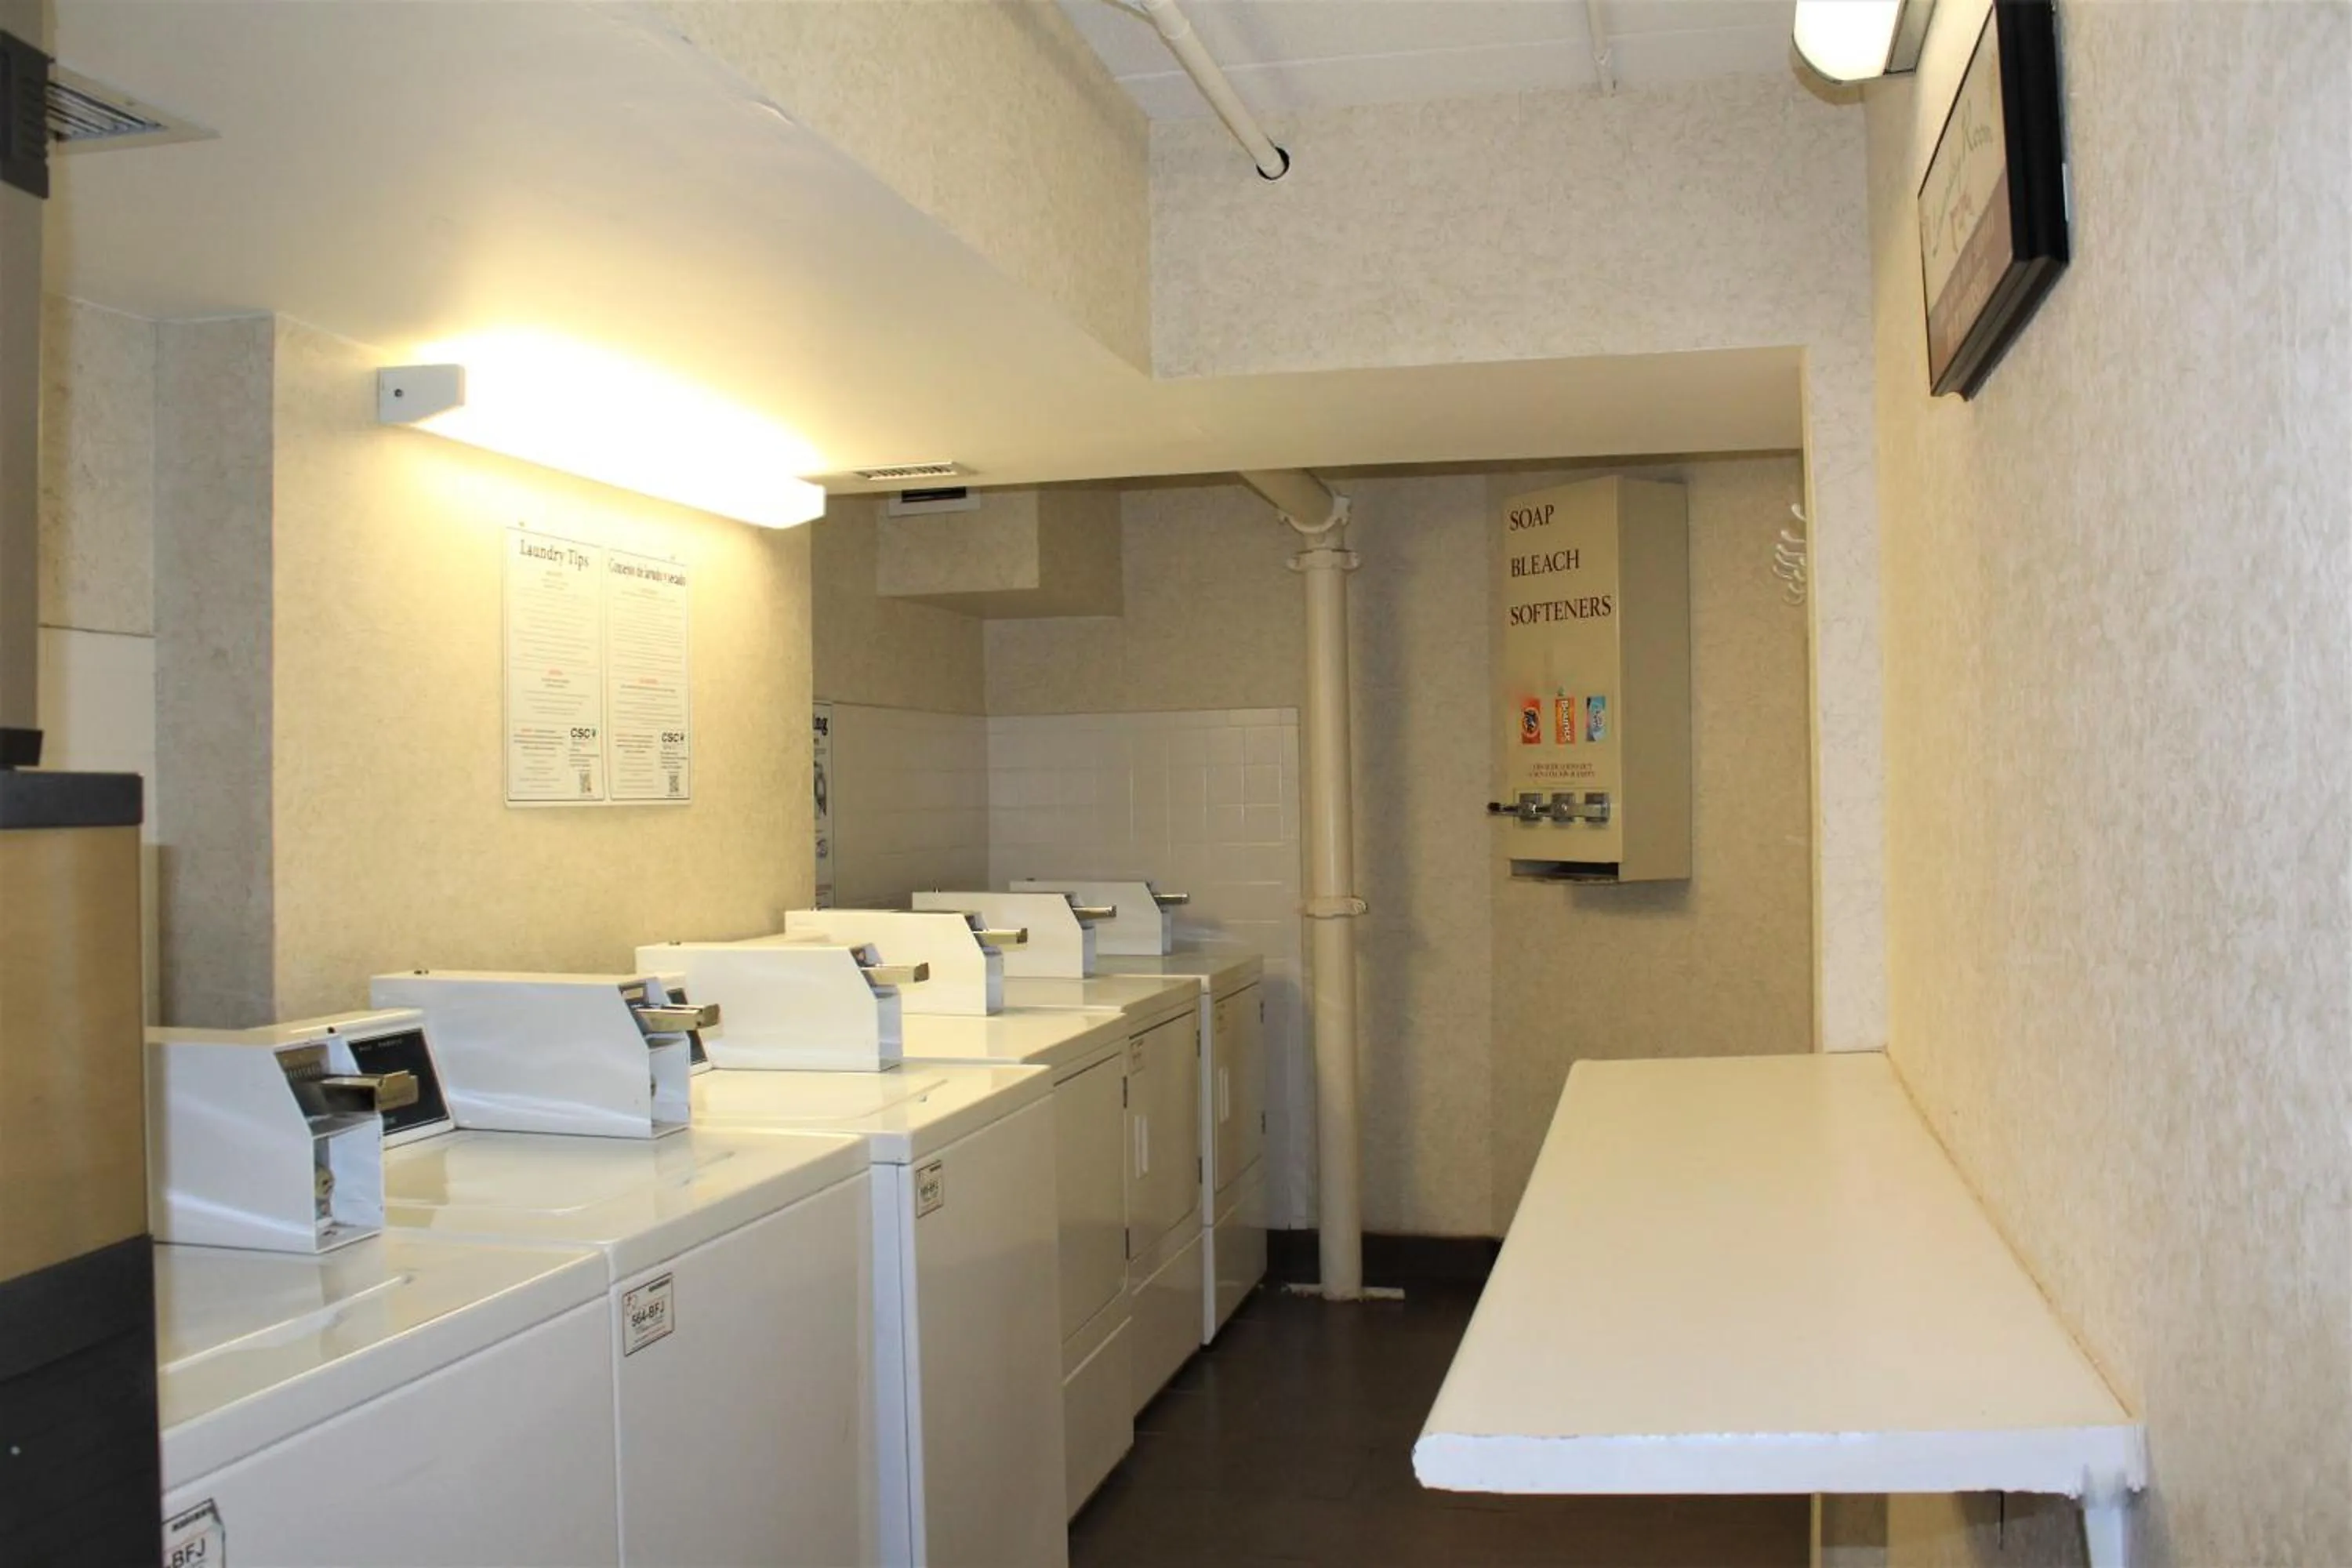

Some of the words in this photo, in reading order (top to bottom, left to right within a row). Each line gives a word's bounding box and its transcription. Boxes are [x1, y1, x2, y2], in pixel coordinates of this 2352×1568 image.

[1509, 503, 1555, 531] SOAP
[519, 539, 565, 567] Laundry
[566, 548, 590, 571] Tips
[1510, 549, 1580, 577] BLEACH
[1510, 595, 1612, 626] SOFTENERS
[570, 728, 590, 739] CSC
[661, 732, 679, 743] CSC
